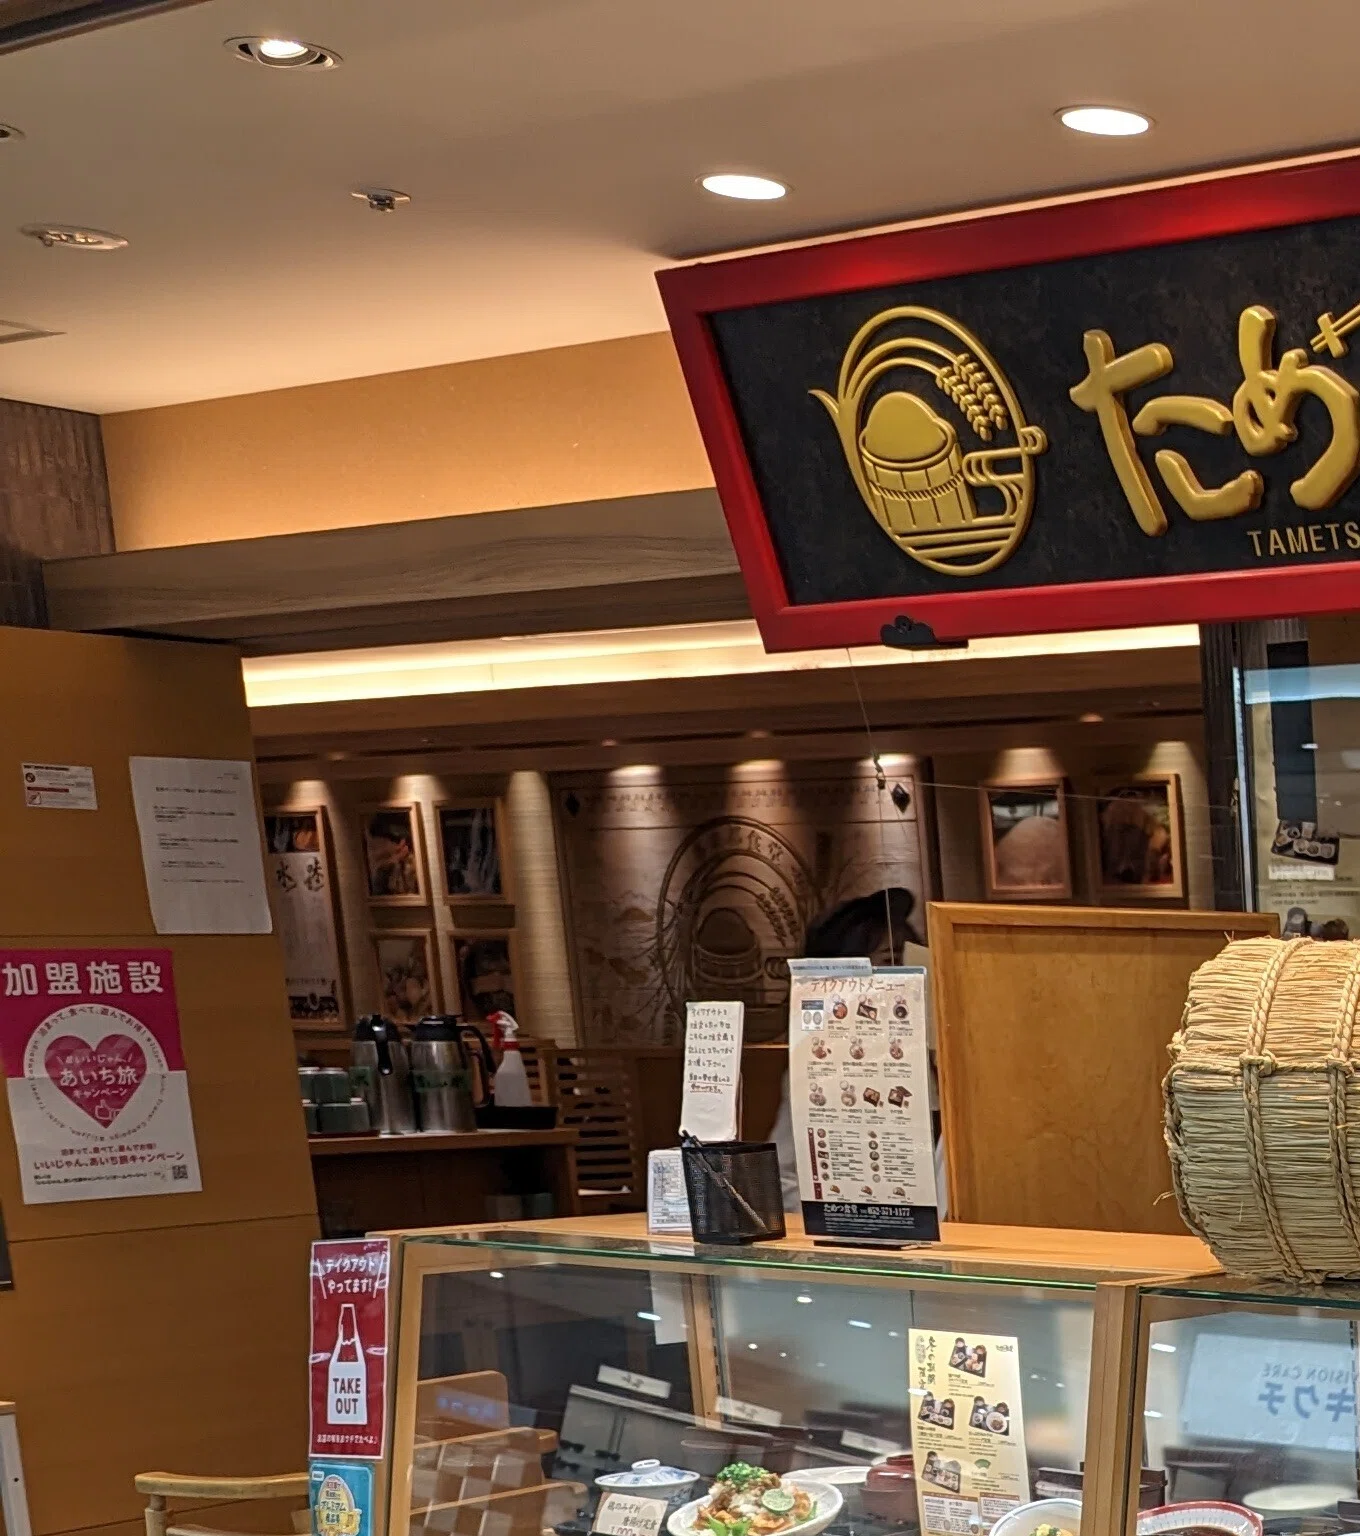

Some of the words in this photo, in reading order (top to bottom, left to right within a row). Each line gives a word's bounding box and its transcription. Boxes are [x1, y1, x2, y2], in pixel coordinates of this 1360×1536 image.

[1, 961, 165, 997] 加盟施設
[810, 978, 906, 993] テイクアウトメニュー
[60, 1066, 139, 1086] あいち旅
[73, 1087, 129, 1098] キャンペーン
[325, 1257, 375, 1274] テイクアウト
[327, 1278, 373, 1295] やってます!
[333, 1377, 361, 1395] TAKE
[335, 1397, 359, 1415] OUT
